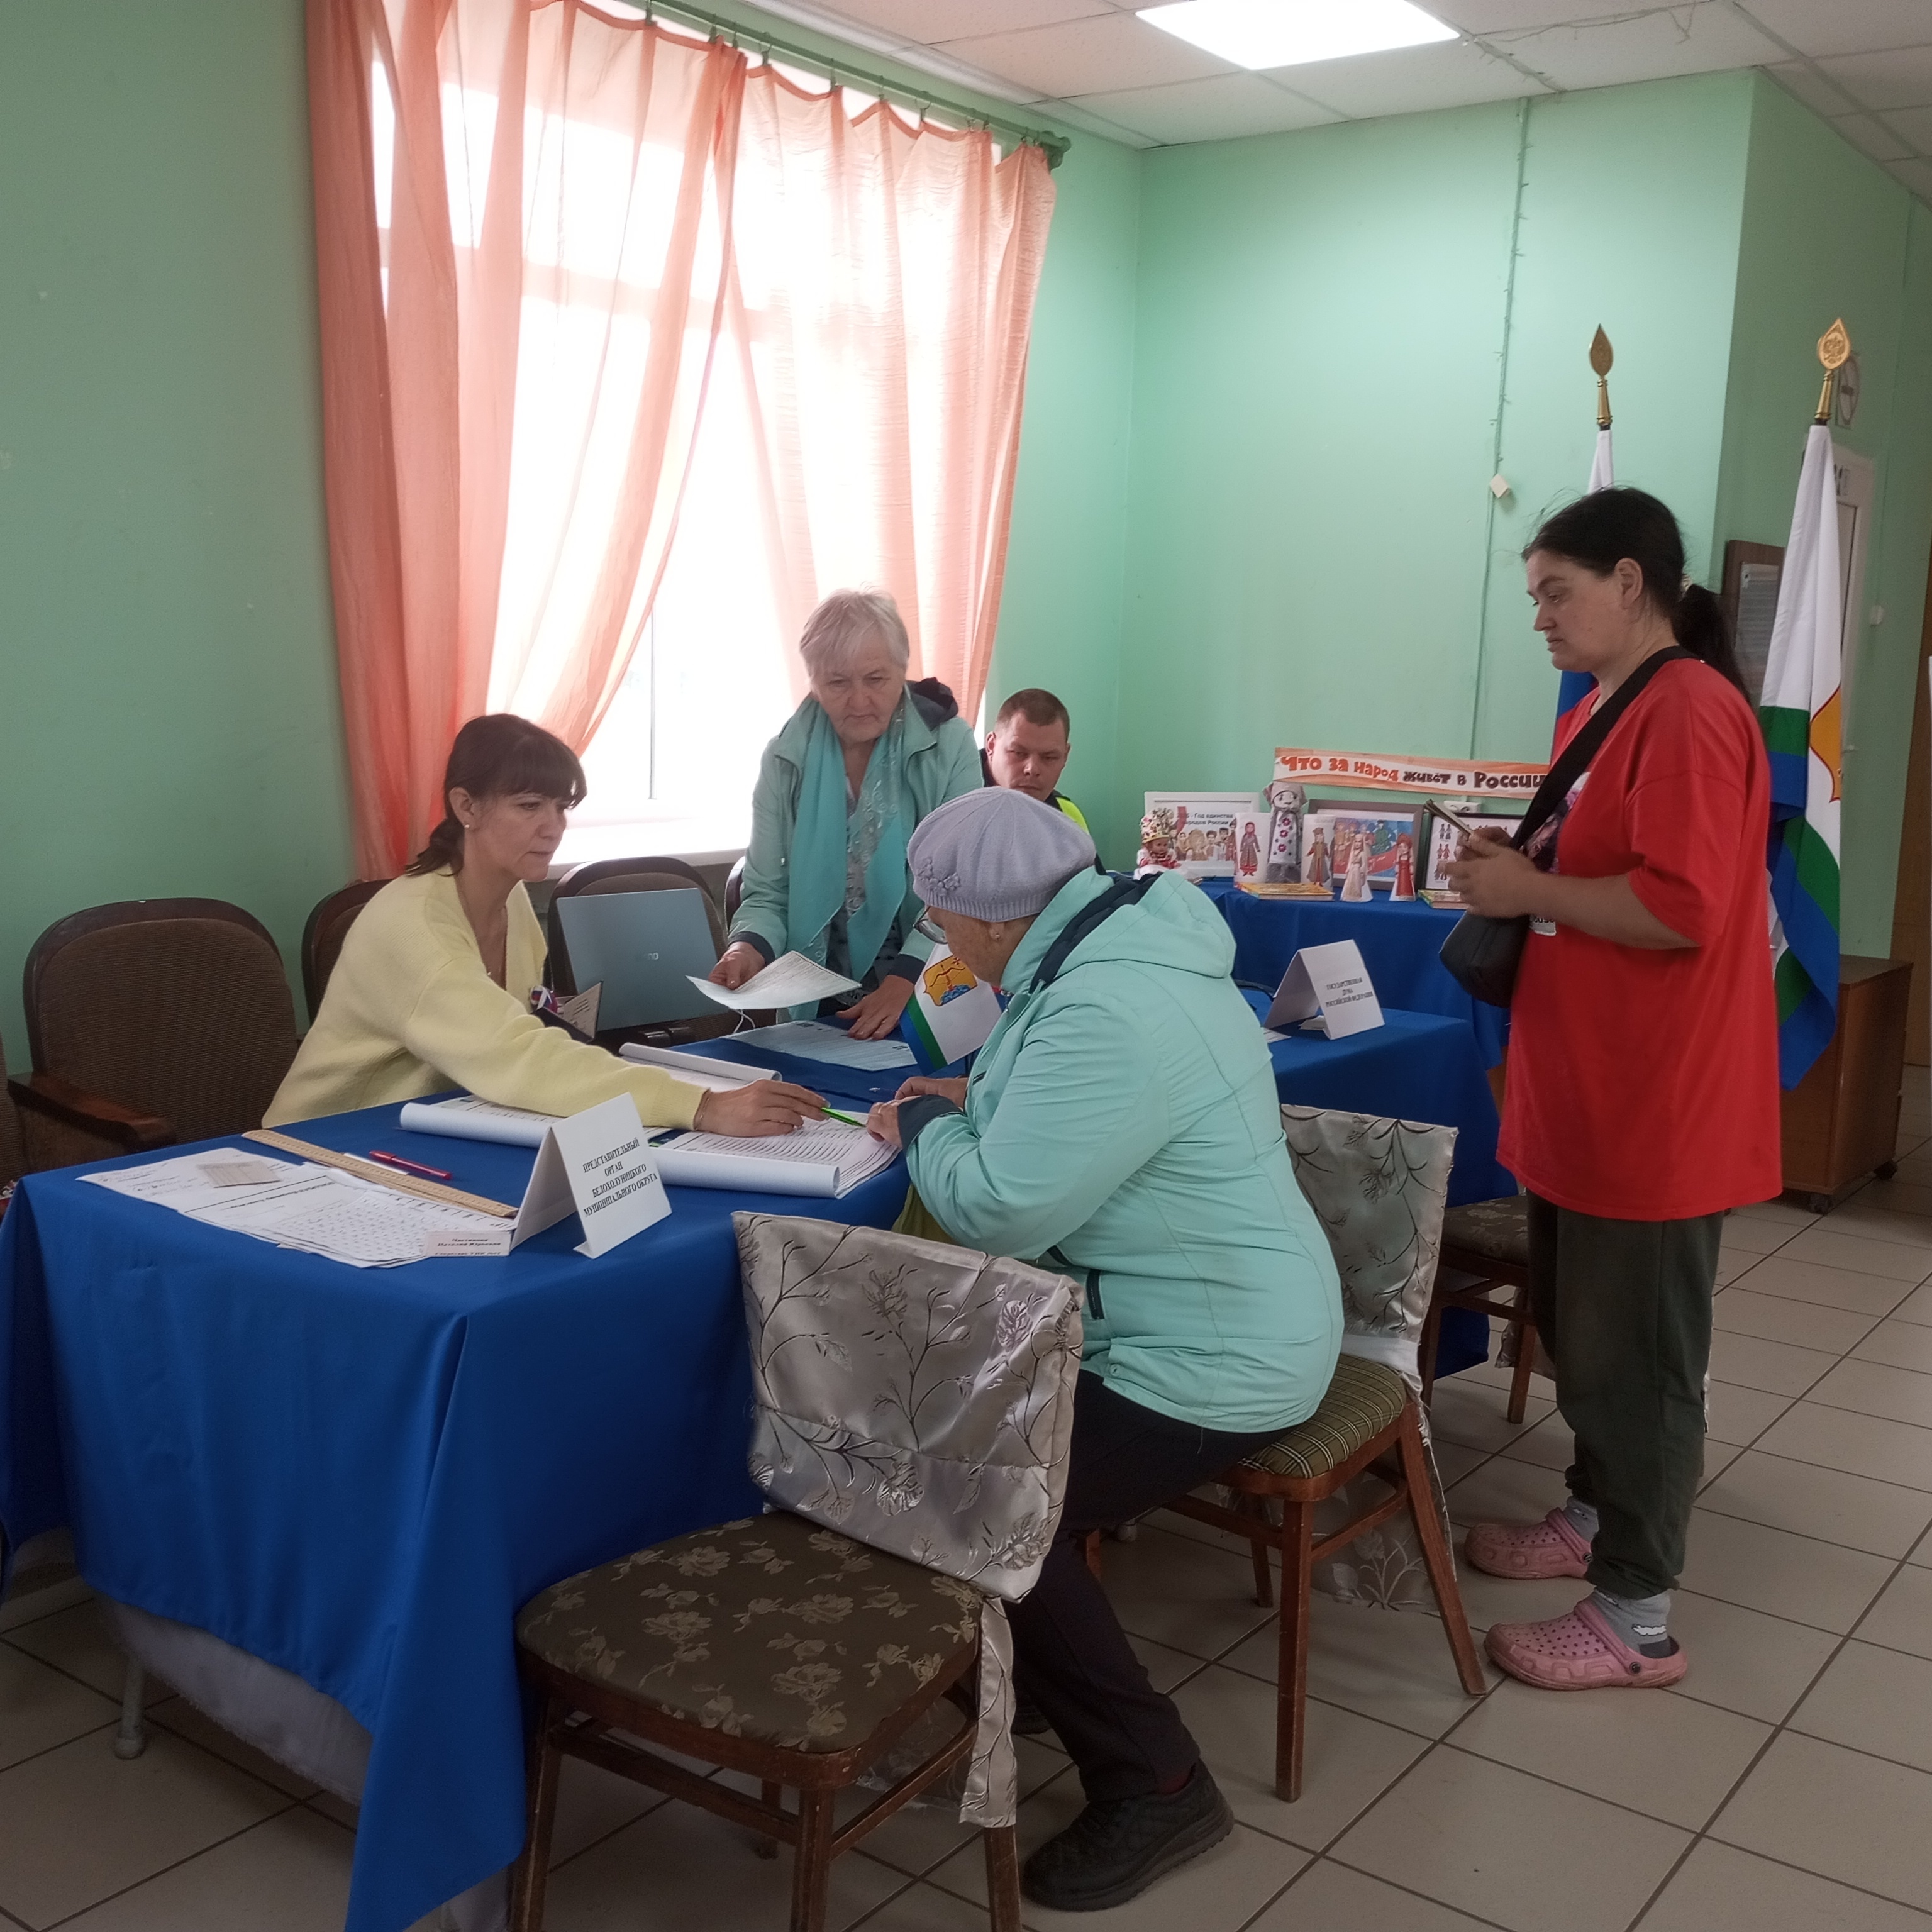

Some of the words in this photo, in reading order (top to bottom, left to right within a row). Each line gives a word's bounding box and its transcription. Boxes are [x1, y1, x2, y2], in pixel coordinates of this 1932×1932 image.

[1281, 756, 1322, 771] Что
[1329, 758, 1348, 772] за
[1353, 762, 1399, 782] народ
[1457, 774, 1467, 786] в
[583, 1137, 640, 1173] ПРЕДСТАВИТЕЛЬНЫЙ
[604, 1161, 623, 1176] ОРГАН
[584, 1183, 636, 1216] МУНИЦИПАЛЬНОГО
[636, 1173, 658, 1189] ОКРУГА
[592, 1163, 647, 1198] БЕЛОХОЛУНИЦКОГО
